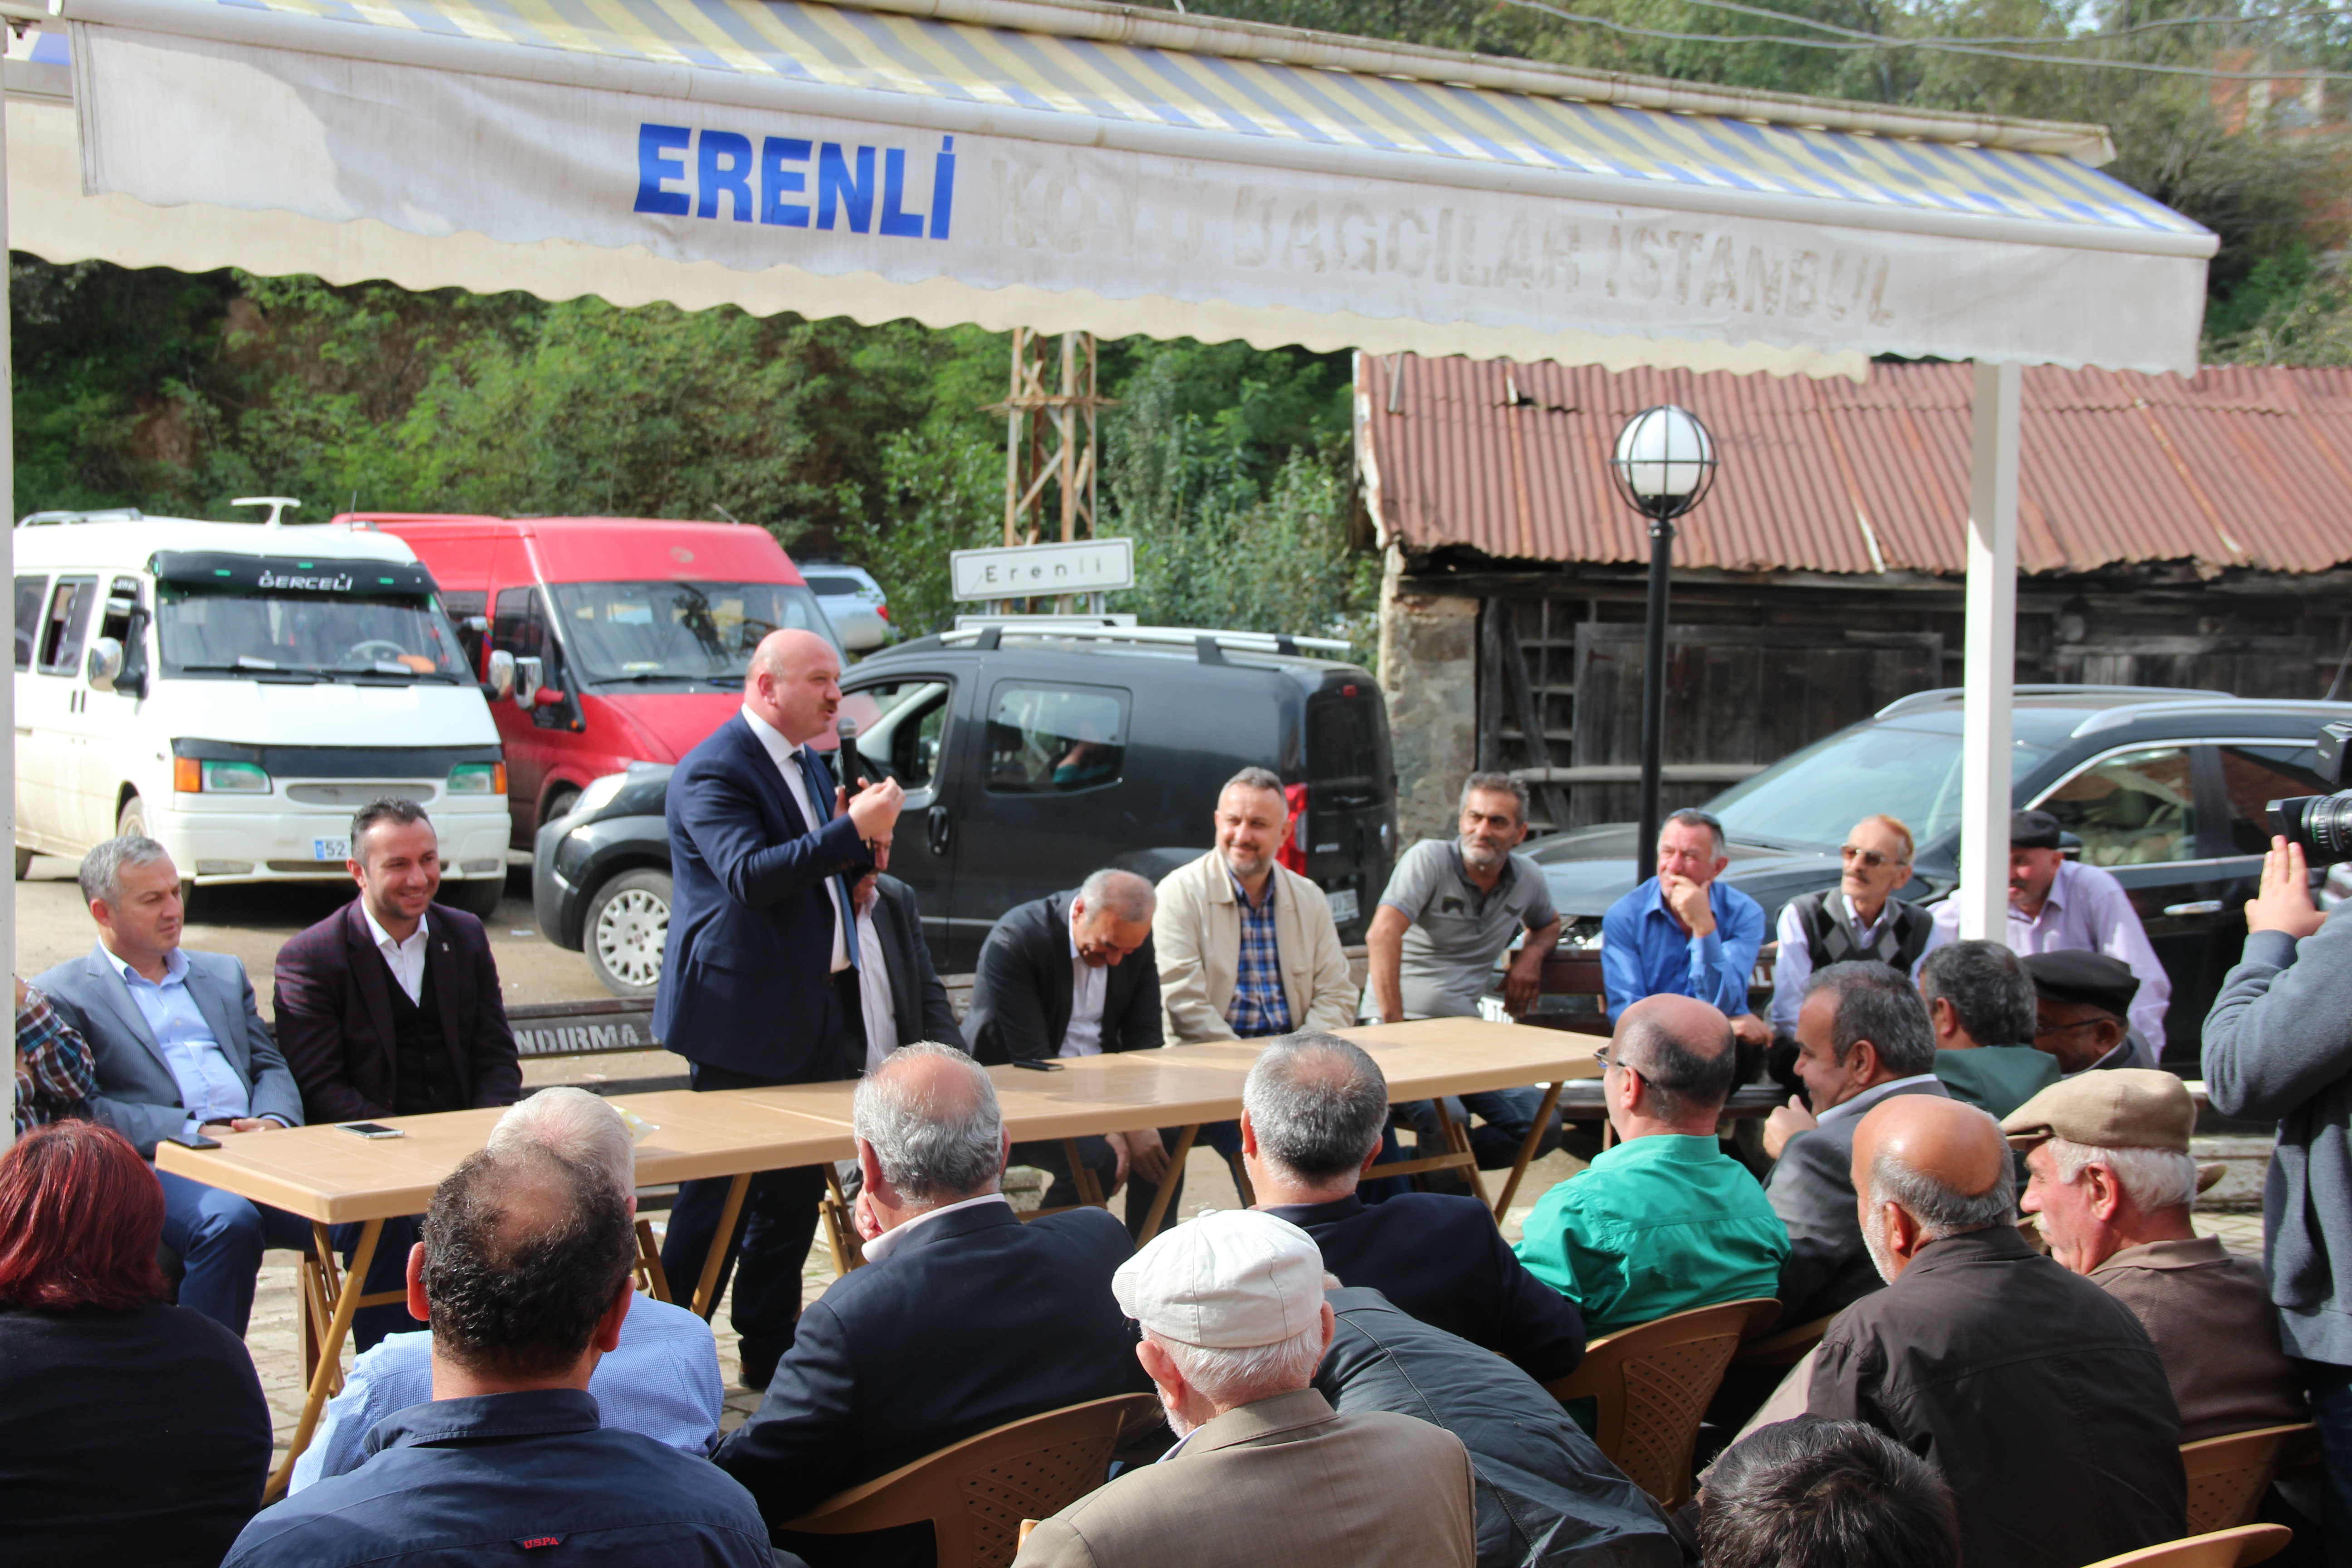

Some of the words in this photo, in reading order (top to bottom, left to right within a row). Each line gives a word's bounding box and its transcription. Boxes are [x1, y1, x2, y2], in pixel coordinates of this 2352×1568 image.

[633, 123, 956, 240] ERENLİ
[985, 557, 1101, 583] Erenli
[326, 840, 347, 857] 52
[523, 1537, 559, 1549] USPA
